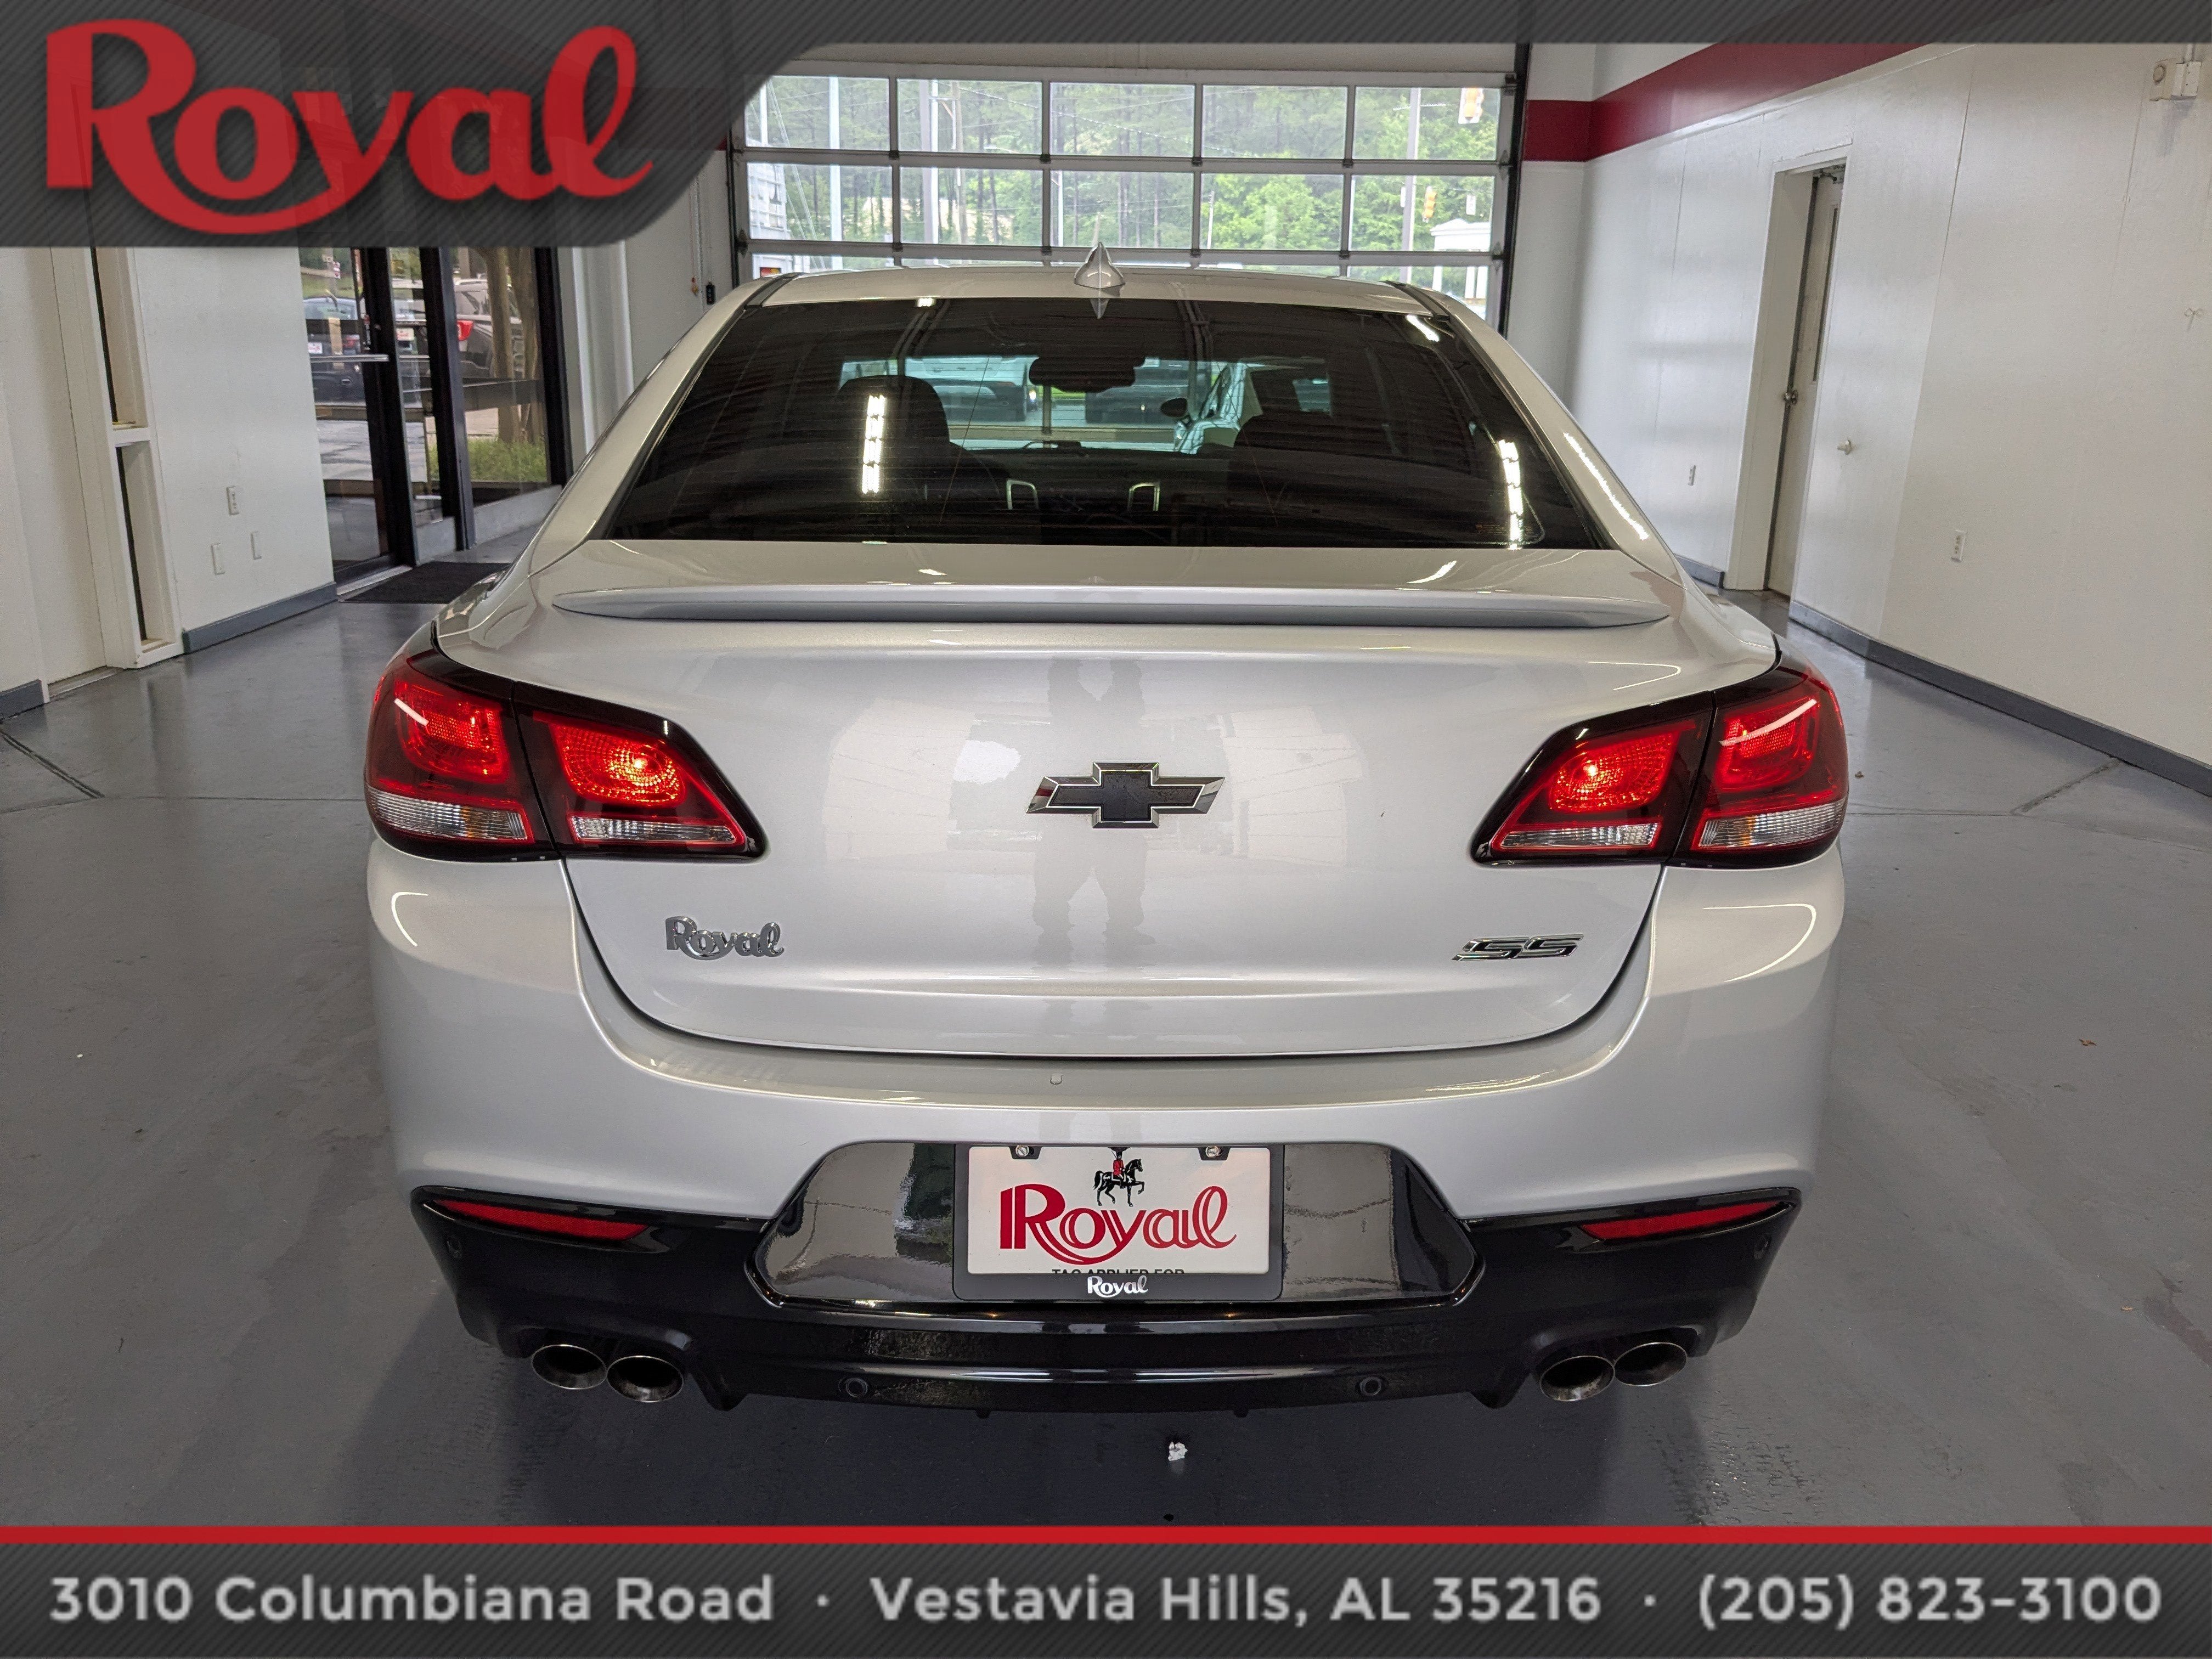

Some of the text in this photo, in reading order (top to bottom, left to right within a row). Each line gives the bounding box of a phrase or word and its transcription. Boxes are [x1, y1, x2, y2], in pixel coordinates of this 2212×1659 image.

[665, 916, 785, 961] Royal
[1451, 934, 1584, 961] SS
[1000, 1183, 1237, 1265] Royal
[1087, 1274, 1149, 1298] Royal
